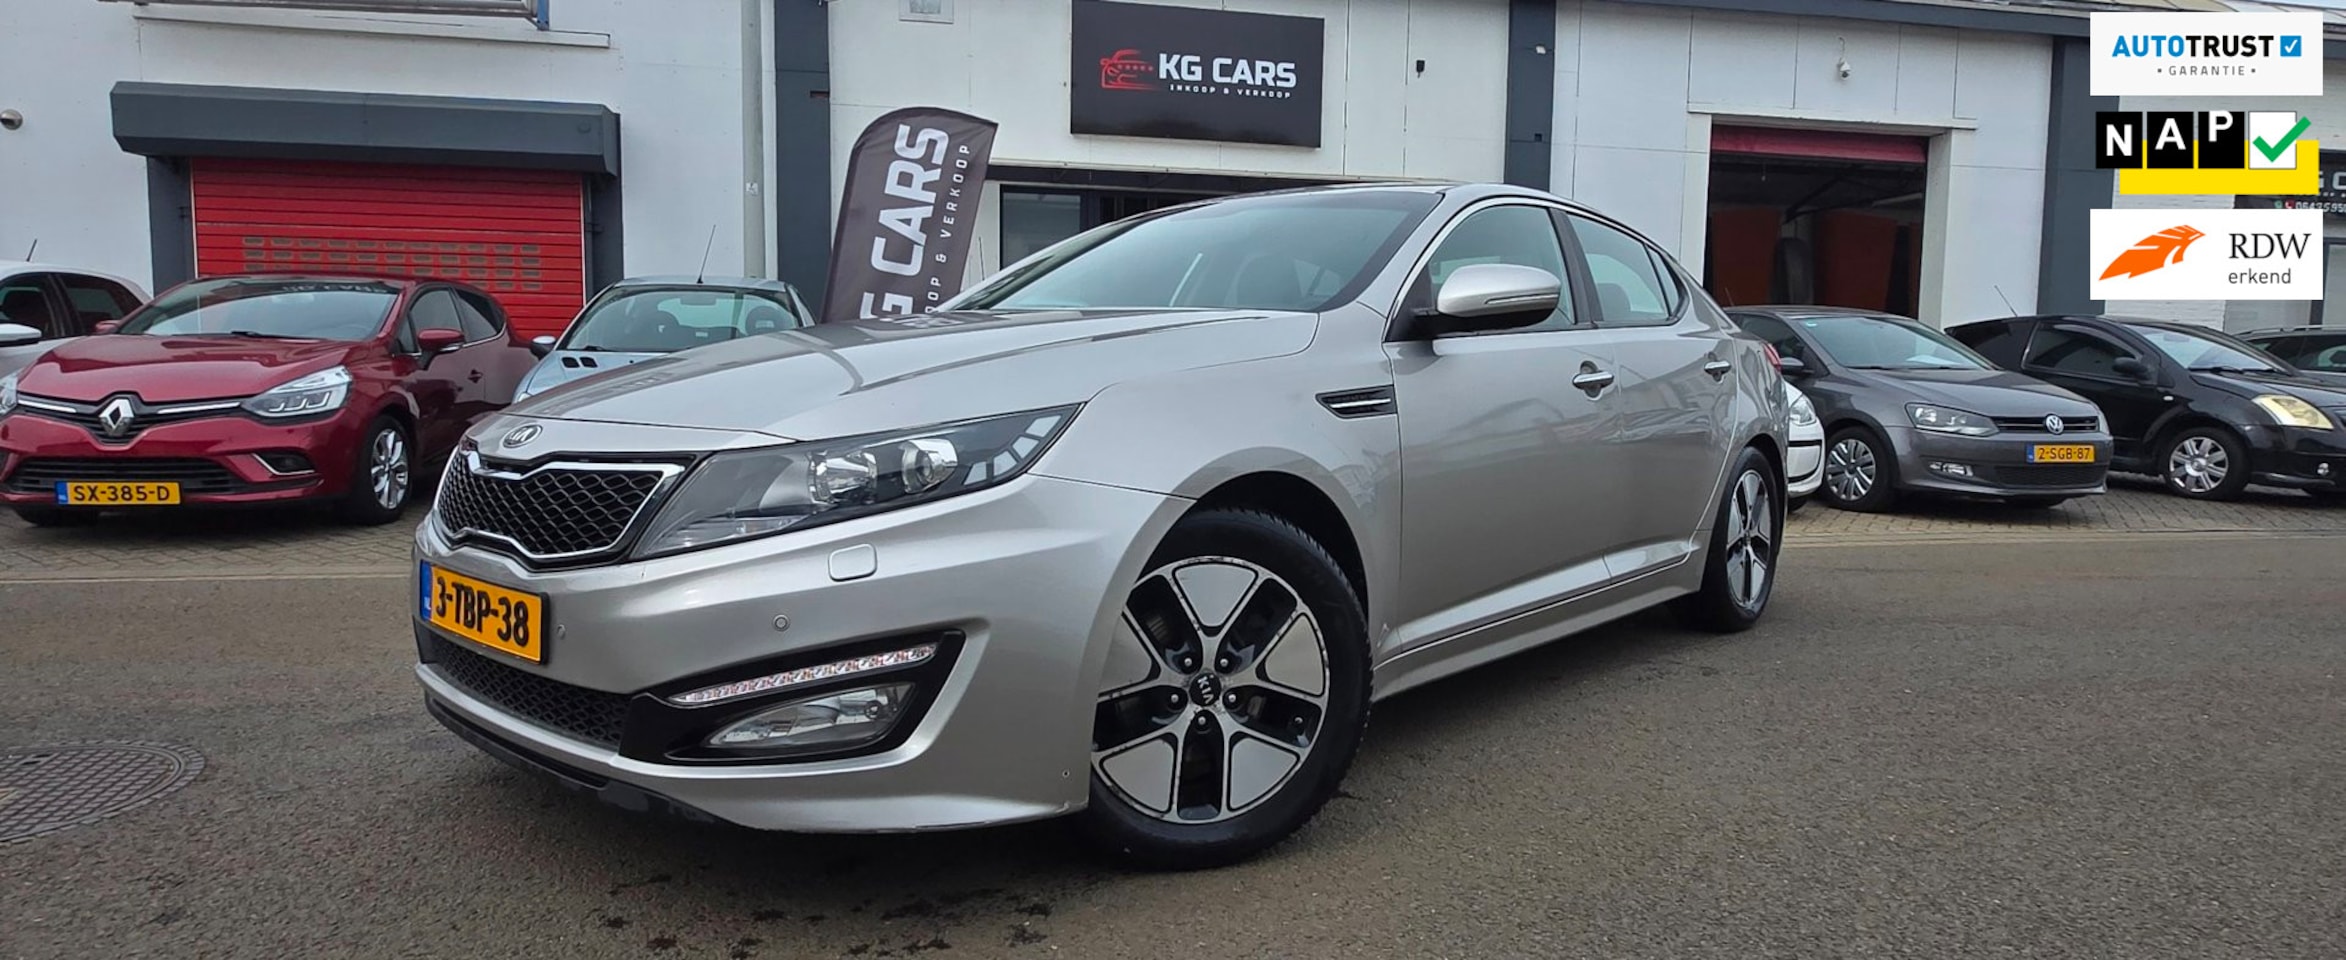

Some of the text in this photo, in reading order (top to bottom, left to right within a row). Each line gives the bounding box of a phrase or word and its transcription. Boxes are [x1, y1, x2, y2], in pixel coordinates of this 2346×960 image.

[1159, 53, 1297, 88] KG CARS
[1169, 84, 1216, 93] INKOOP
[1237, 89, 1291, 98] VERKOOP
[940, 145, 971, 238] VERKOOP
[860, 124, 949, 319] G CARS
[935, 253, 947, 263] &
[2038, 447, 2091, 460] 2-SGB-87
[73, 485, 170, 502] SX-385-D
[435, 576, 530, 648] 3-TBP-38
[1197, 675, 1215, 704] KIA
